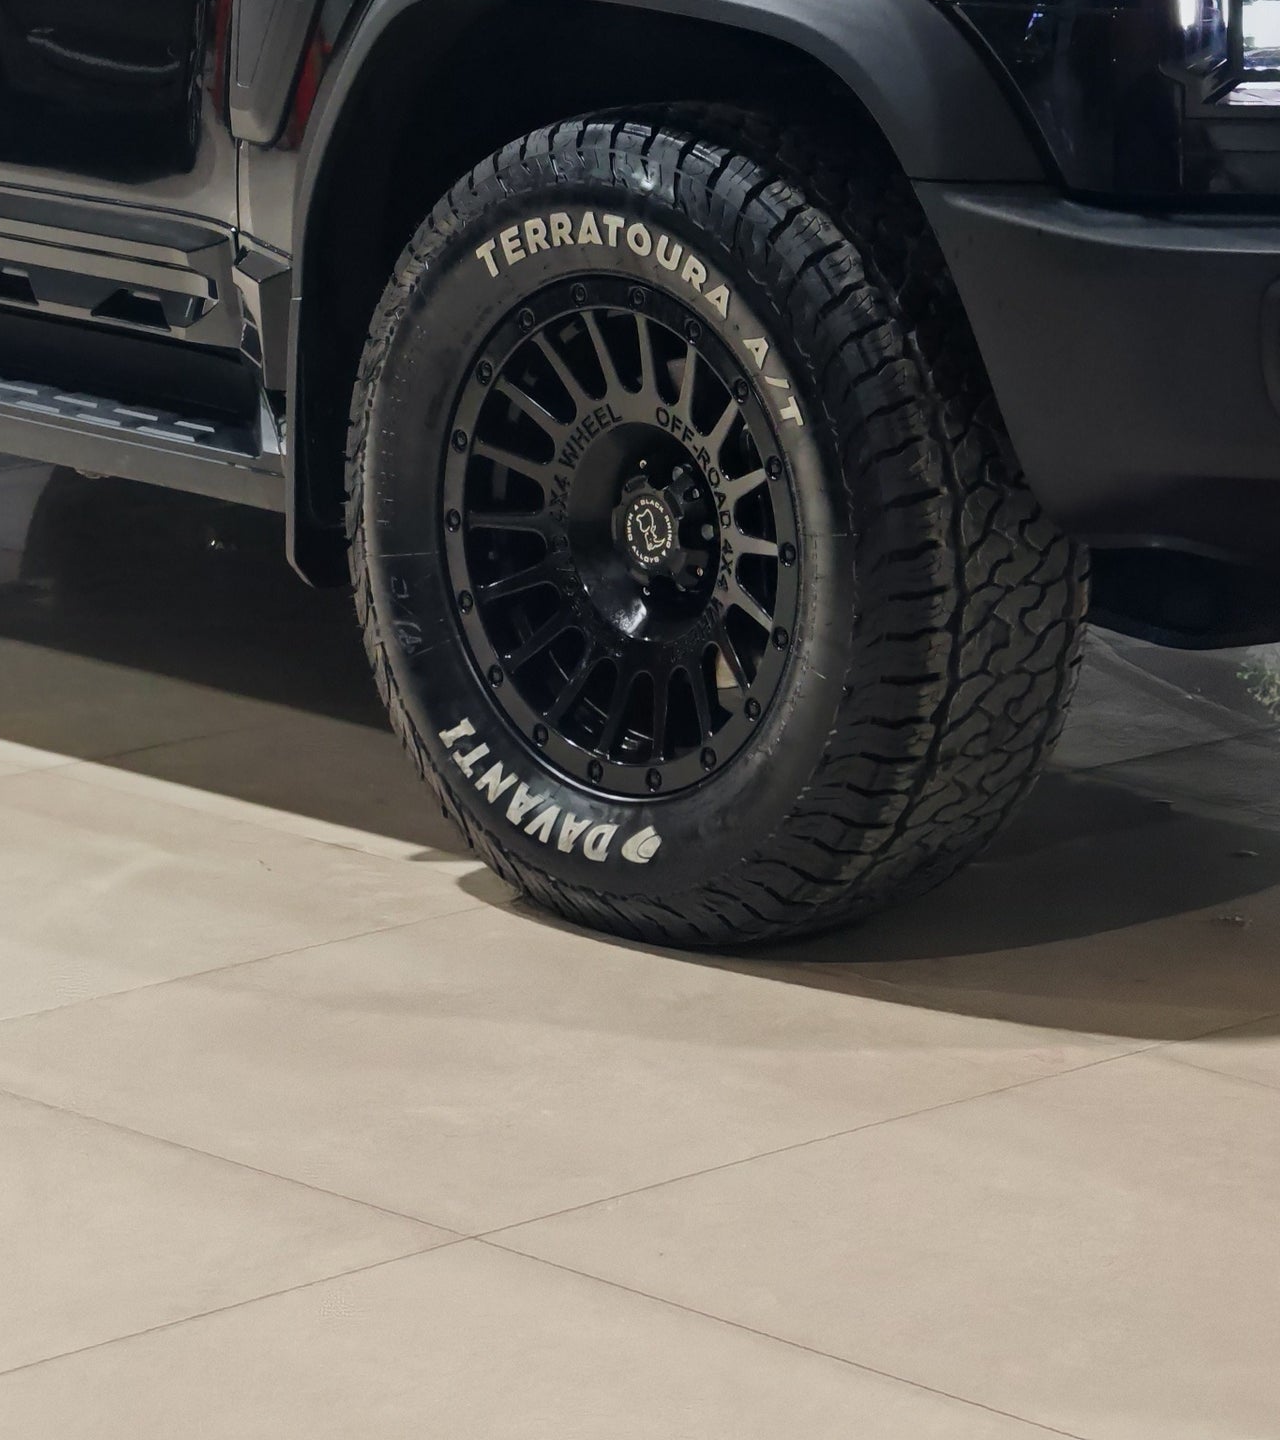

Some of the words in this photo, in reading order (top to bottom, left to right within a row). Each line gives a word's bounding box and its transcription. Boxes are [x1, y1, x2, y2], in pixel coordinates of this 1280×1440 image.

[475, 211, 732, 320] TERRATOURA
[742, 336, 805, 427] A/T
[559, 403, 623, 470] WHEEL
[656, 406, 731, 529] OFF-ROAD
[631, 545, 660, 563] ALLOYS
[640, 499, 665, 513] BLACK
[664, 515, 673, 549] RHINO
[438, 717, 620, 862] DAVANTI
